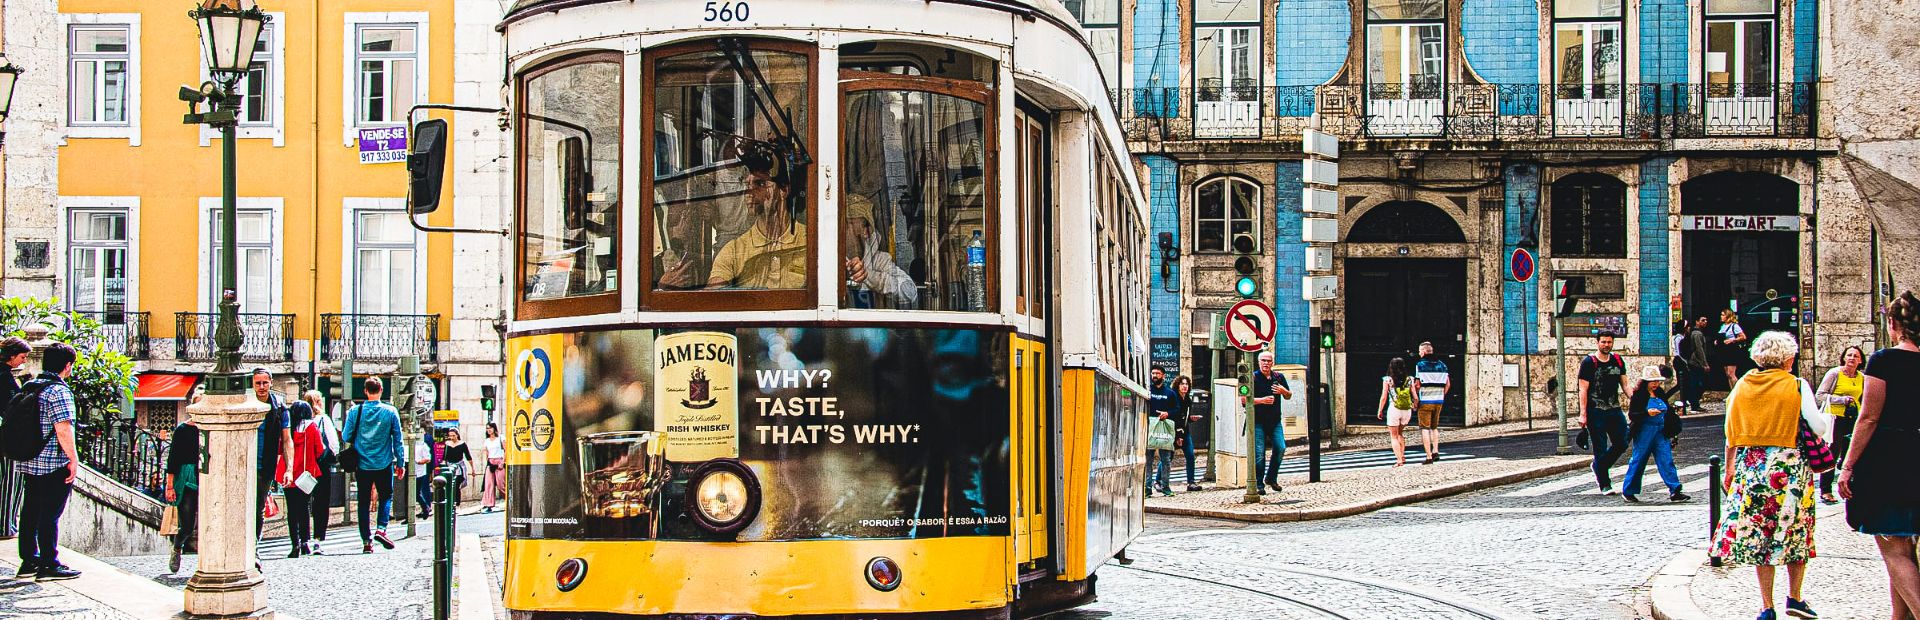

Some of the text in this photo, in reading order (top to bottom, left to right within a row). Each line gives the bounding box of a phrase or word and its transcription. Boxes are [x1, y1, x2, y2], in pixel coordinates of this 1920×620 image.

[704, 2, 749, 22] 560
[361, 129, 404, 140] VENDE-SE
[377, 140, 389, 150] T2
[361, 151, 406, 161] 917 333 035
[1694, 216, 1776, 230] FOLK ART
[532, 282, 547, 296] 08
[660, 343, 735, 370] JAMESON
[755, 369, 832, 388] WHY?
[755, 397, 845, 419] TASTE,
[693, 424, 730, 432] WHISKEY
[755, 424, 845, 444] THAT’S
[907, 518, 914, 526] O
[949, 515, 954, 525] É
[956, 517, 975, 525] ESSA
[984, 515, 1007, 524] RAZÃO
